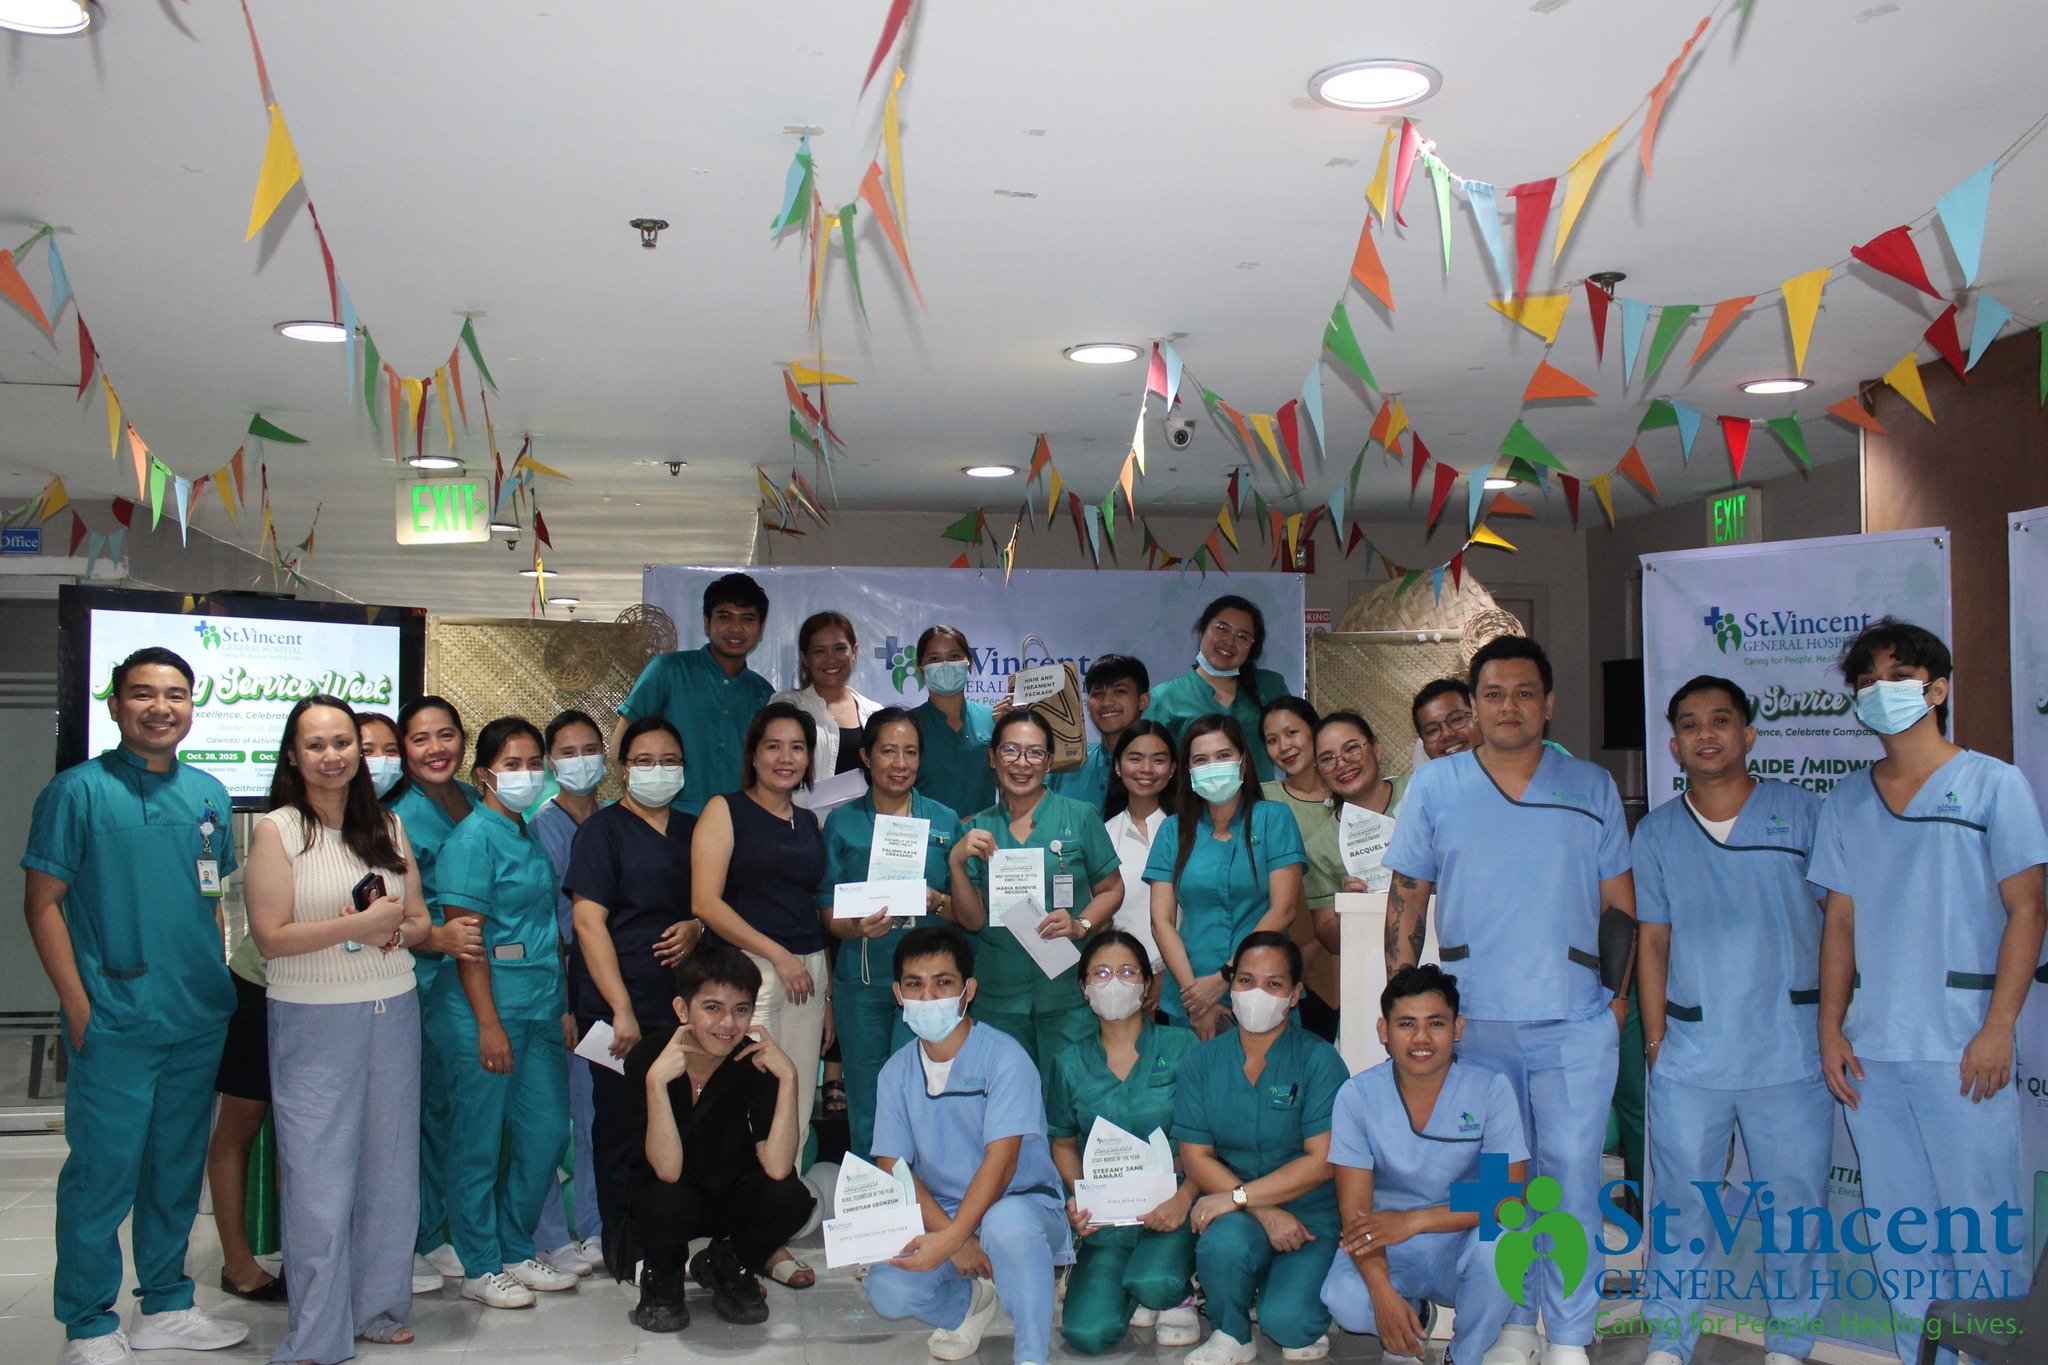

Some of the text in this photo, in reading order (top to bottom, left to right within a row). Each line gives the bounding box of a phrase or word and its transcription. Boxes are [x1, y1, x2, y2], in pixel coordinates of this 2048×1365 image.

[411, 484, 477, 533] EXIT
[1714, 494, 1746, 543] EXIT
[1, 536, 39, 548] Office
[1304, 613, 1330, 621] KING
[1743, 610, 1871, 638] St.Vincent
[222, 626, 303, 645] St.Vincent
[222, 643, 303, 654] GENERAL HOSPITAL
[1743, 639, 1801, 652] GENERAL
[1744, 657, 1769, 667] Caring
[1771, 655, 1782, 664] for
[1784, 654, 1814, 665] People.
[215, 666, 319, 705] Service
[318, 670, 391, 704] Week
[965, 681, 1007, 693] ERAL
[1023, 682, 1055, 691] TREAMENT
[1025, 689, 1053, 698] PACKAGE
[1761, 685, 1849, 721] Service
[1756, 727, 1782, 737] lence,
[1785, 727, 1830, 736] Celebrate
[206, 736, 240, 744] Calendar
[205, 753, 217, 761] 28,
[259, 753, 275, 761] Oct.
[1747, 759, 1795, 773] AIDE
[1349, 844, 1383, 858] RACQUEL
[1093, 1166, 1123, 1174] STEFANY
[843, 1204, 871, 1213] CHRISTIAN
